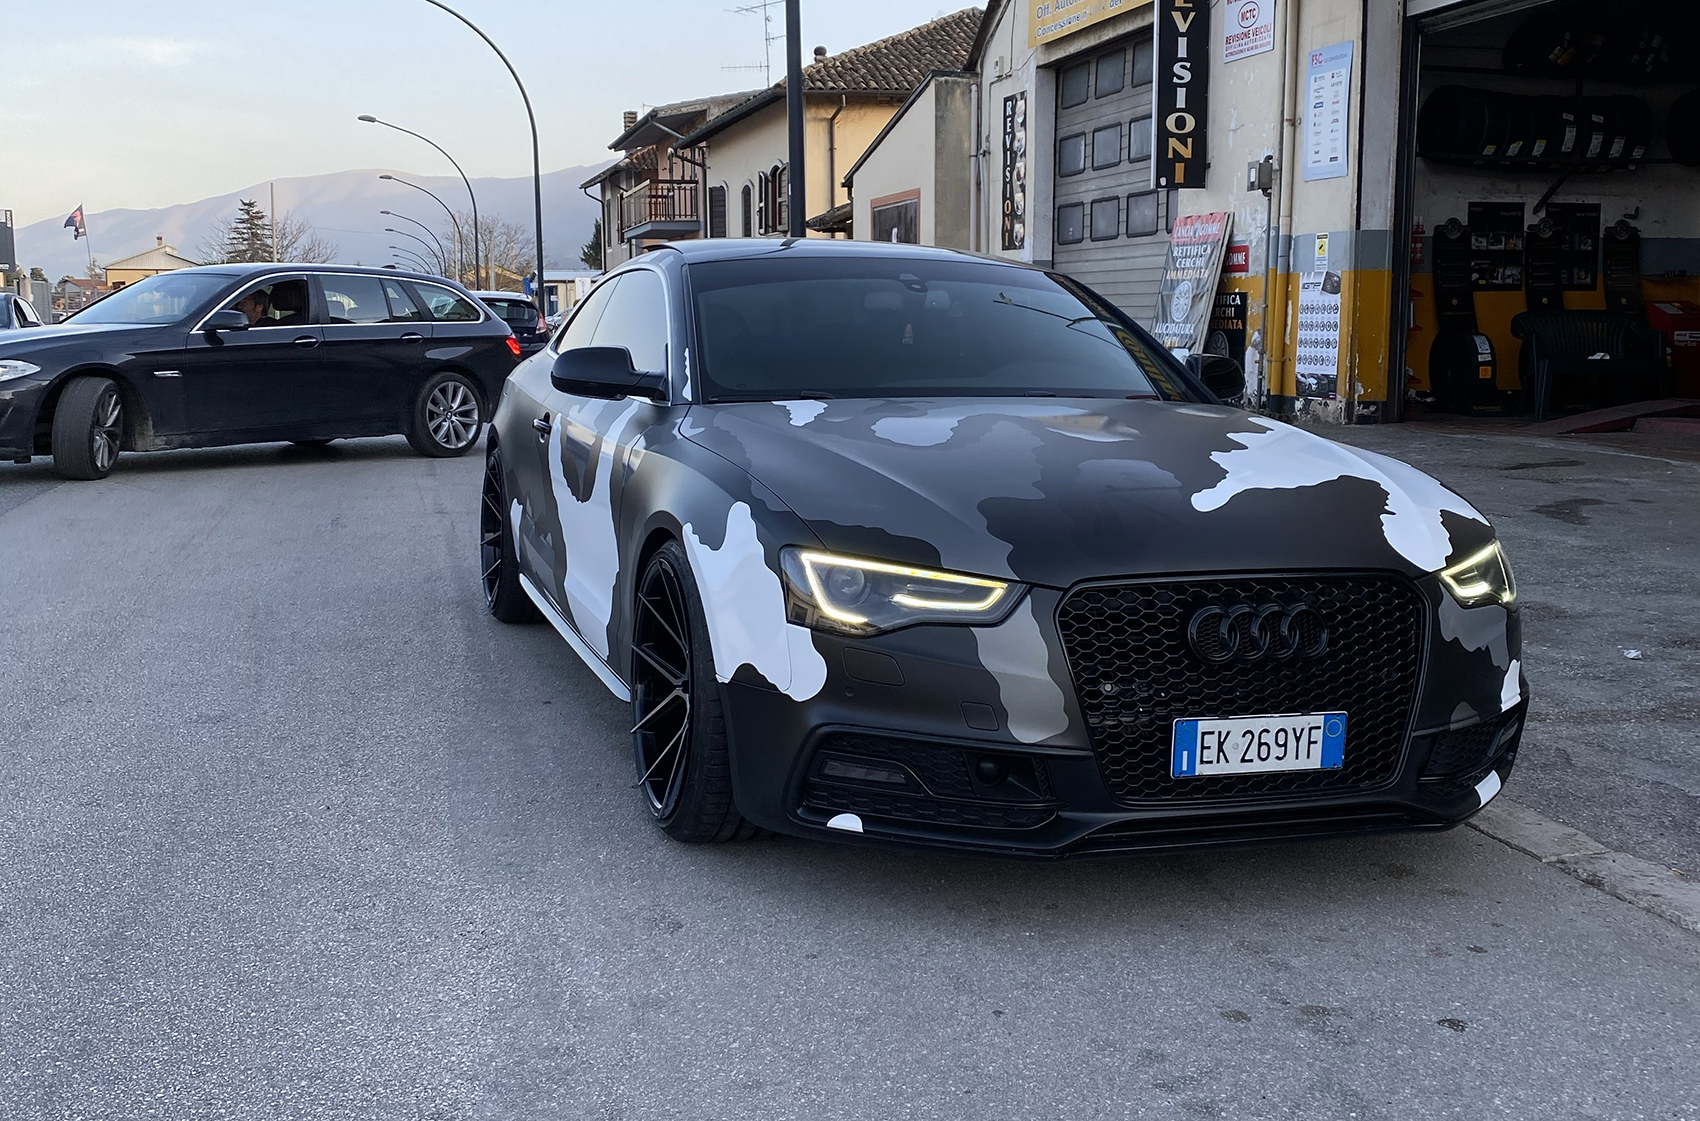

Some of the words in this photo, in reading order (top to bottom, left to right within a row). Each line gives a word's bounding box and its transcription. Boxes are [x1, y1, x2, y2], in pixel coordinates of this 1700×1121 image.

[1036, 3, 1052, 20] Off.
[1036, 12, 1080, 38] Concessione
[1225, 29, 1251, 46] REVISIONE
[1252, 22, 1272, 38] VEICOLI
[1166, 0, 1196, 184] VISIONI
[1004, 100, 1013, 247] REVISIONI
[1172, 244, 1211, 257] RETTIFICA
[1225, 251, 1246, 266] GOMME
[1175, 257, 1205, 268] CERCHI
[1166, 268, 1208, 280] IMMEDIATA
[1215, 294, 1242, 306] TIFICA
[1154, 322, 1195, 335] LUCIDATURA
[1200, 730, 1231, 765] EK
[1240, 725, 1321, 764] 269YF
